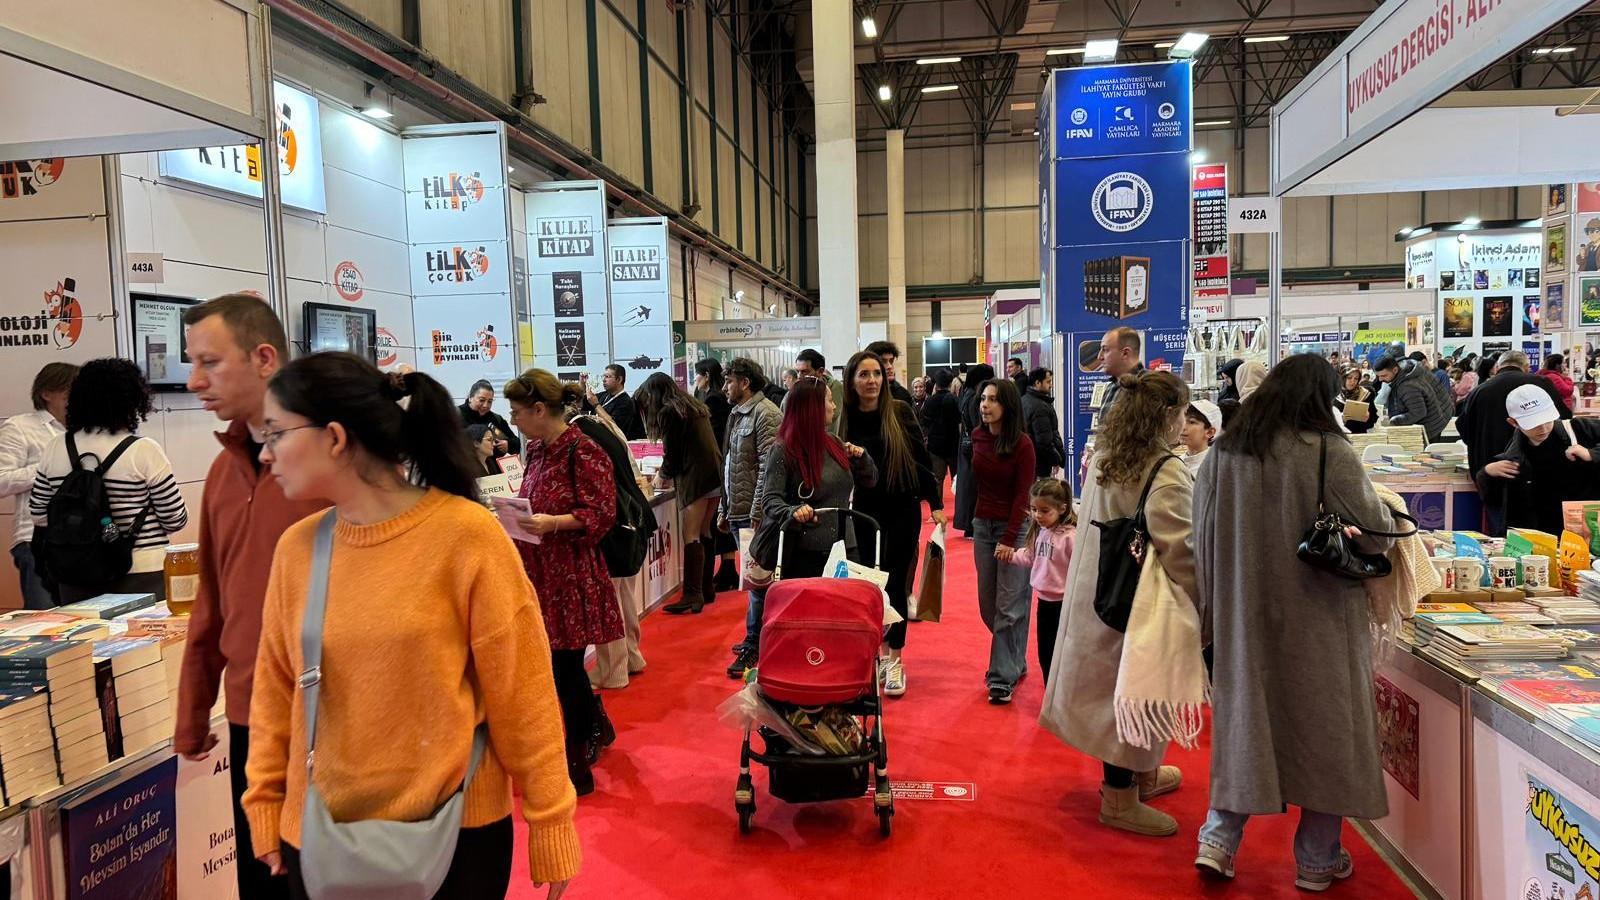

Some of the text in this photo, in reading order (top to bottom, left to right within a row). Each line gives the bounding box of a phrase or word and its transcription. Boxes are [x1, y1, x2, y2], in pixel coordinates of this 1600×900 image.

[1348, 42, 1398, 114] UYKUSUZ
[1401, 0, 1454, 76] DERGİSİ
[1081, 84, 1110, 93] İLAHİYAT
[1112, 82, 1146, 90] FAKÜLTESİ
[1108, 125, 1138, 133] ÇAMLICA
[0, 176, 37, 196] UK
[425, 200, 468, 212] Kitap
[1240, 210, 1266, 220] 432A
[542, 220, 588, 235] KULE
[542, 238, 590, 255] KİTAP
[1504, 243, 1540, 254] Adam
[615, 249, 657, 262] HARP
[132, 263, 154, 272] 443A
[614, 265, 658, 279] SANAT
[0, 310, 48, 331] OLOJİ
[213, 756, 230, 776] AL
[95, 783, 158, 828] ALİ ORUÇ
[89, 811, 161, 863] Botan'da Her
[209, 826, 235, 849] Bota
[1531, 788, 1600, 884] UYKUSUZ
[80, 826, 170, 896] Mevsim İsyandır
